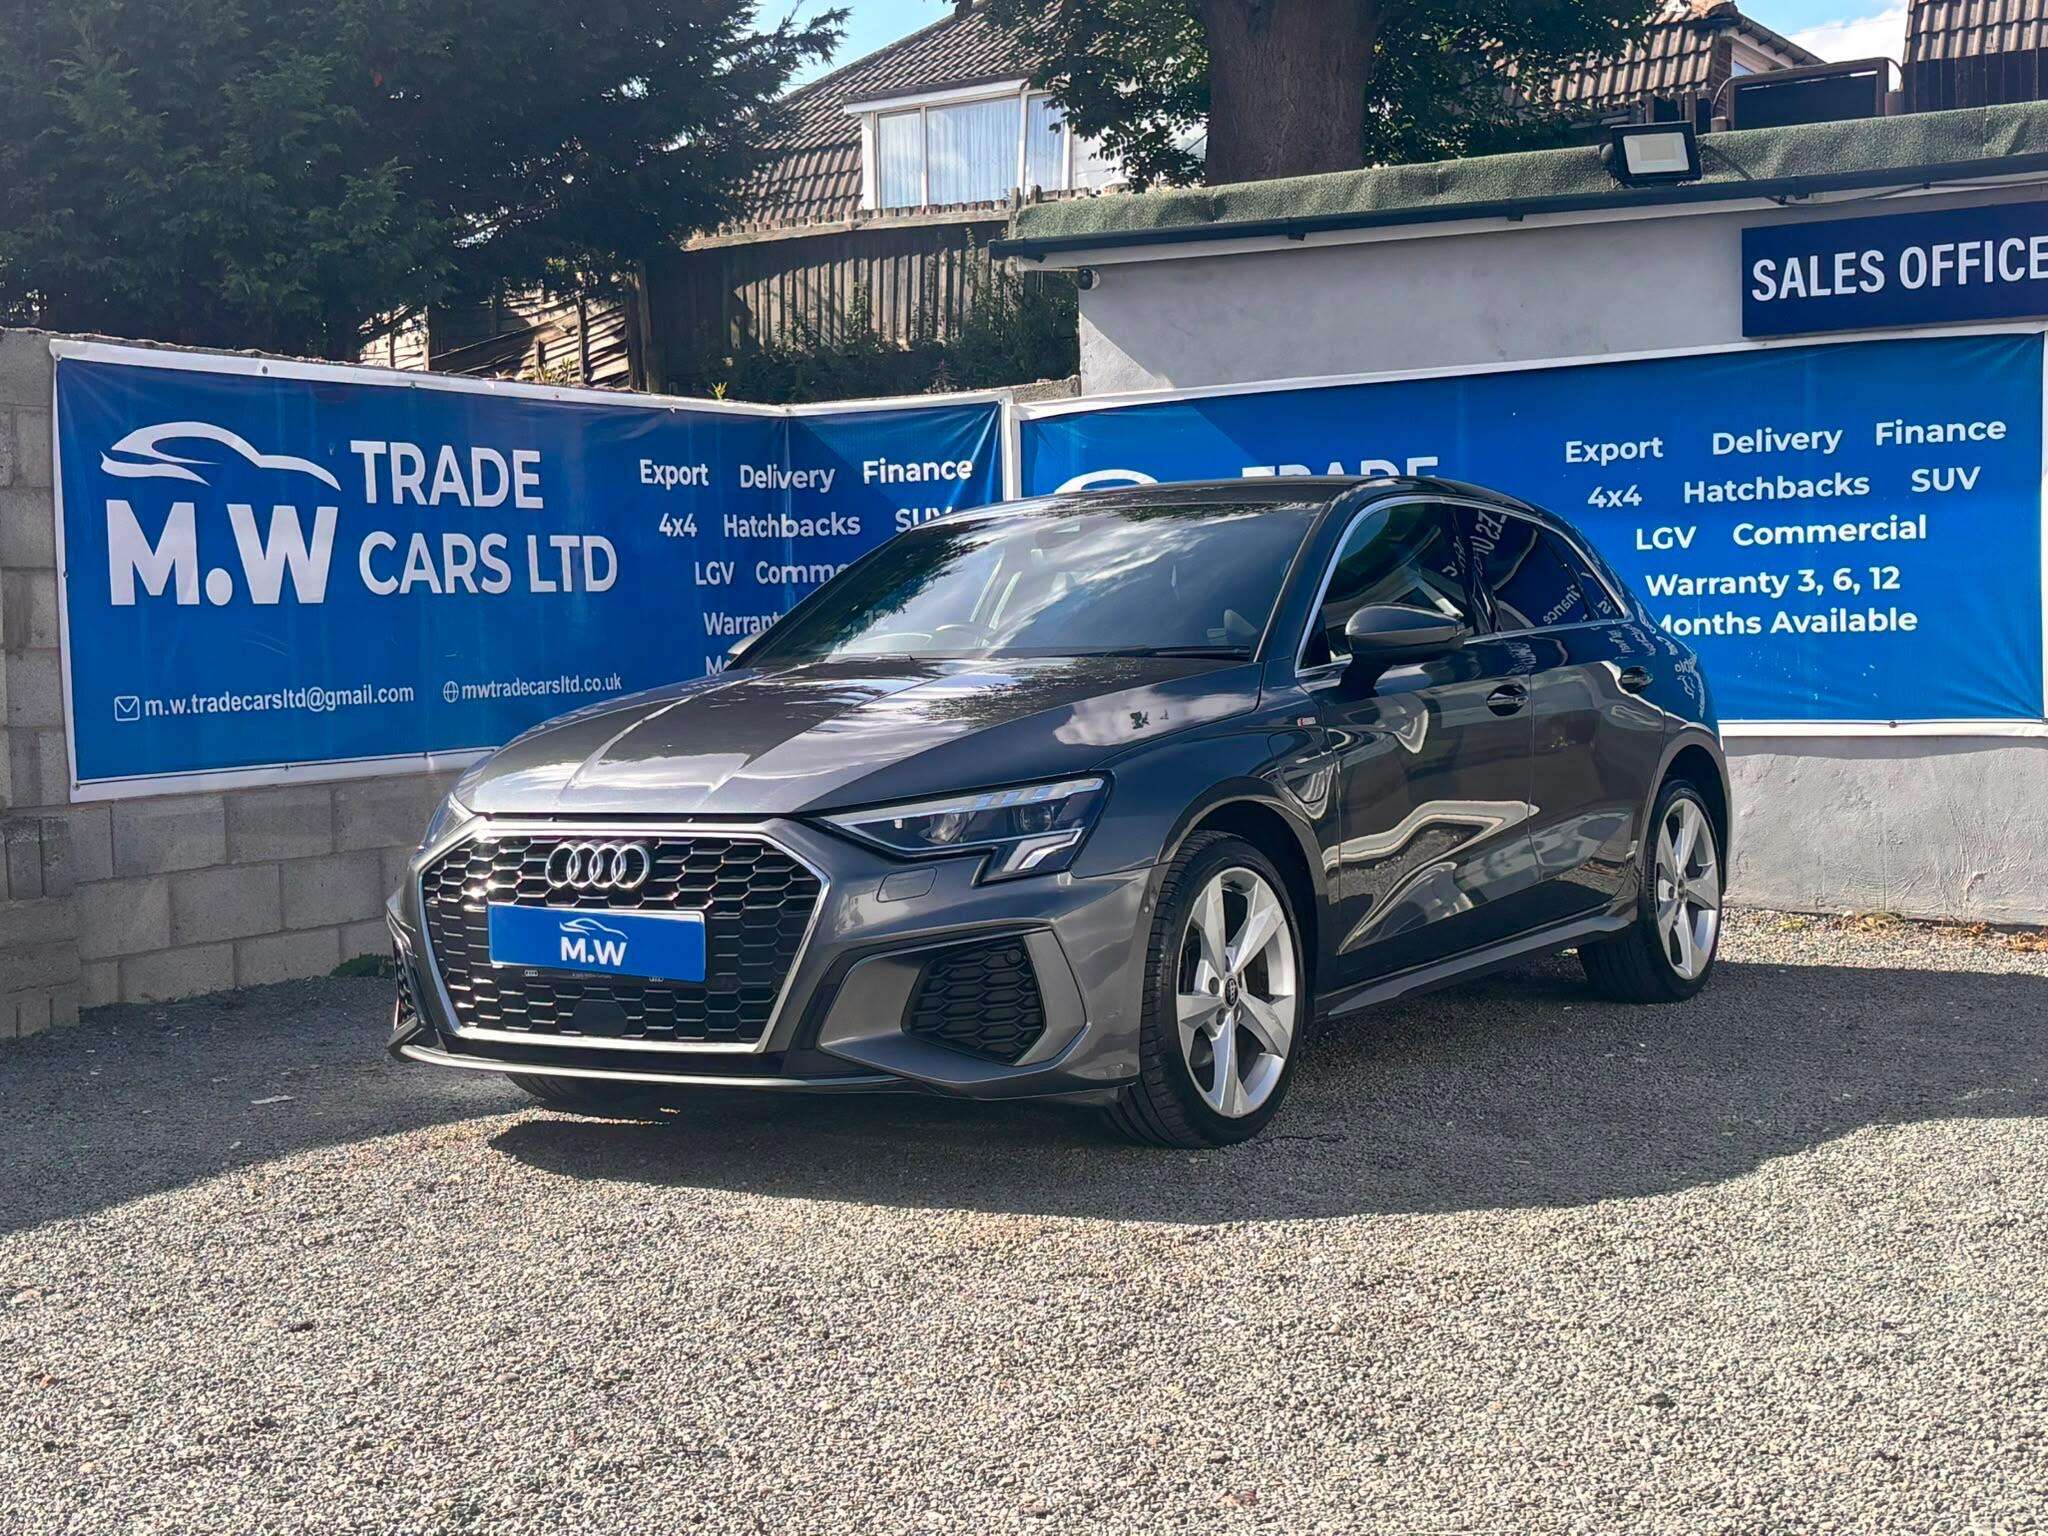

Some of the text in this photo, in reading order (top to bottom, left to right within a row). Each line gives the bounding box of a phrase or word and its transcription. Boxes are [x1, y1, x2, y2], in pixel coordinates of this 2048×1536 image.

[1752, 235, 2048, 301] SALES OFFICE
[1566, 419, 2007, 466] Export Delivery Finance
[350, 440, 544, 509] TRADE
[639, 457, 973, 493] Export Delivery Finance
[1588, 466, 1981, 508] 4x4 Hatchbacks SUV
[659, 512, 698, 537] 4x4
[724, 511, 861, 538] Hatchbacks
[1637, 514, 1926, 550] LGV Commercial
[106, 499, 340, 606] M.W
[358, 531, 618, 595] CARS LTD
[695, 561, 735, 585] LGV
[1645, 566, 1901, 599] Warranty 3, 6, 12
[1770, 608, 1918, 634] Available
[145, 684, 414, 716] m.w.tradecarsltd@gmail.com
[461, 675, 622, 701] mwtradecarsltd.co.uk
[560, 936, 627, 967] M.W
